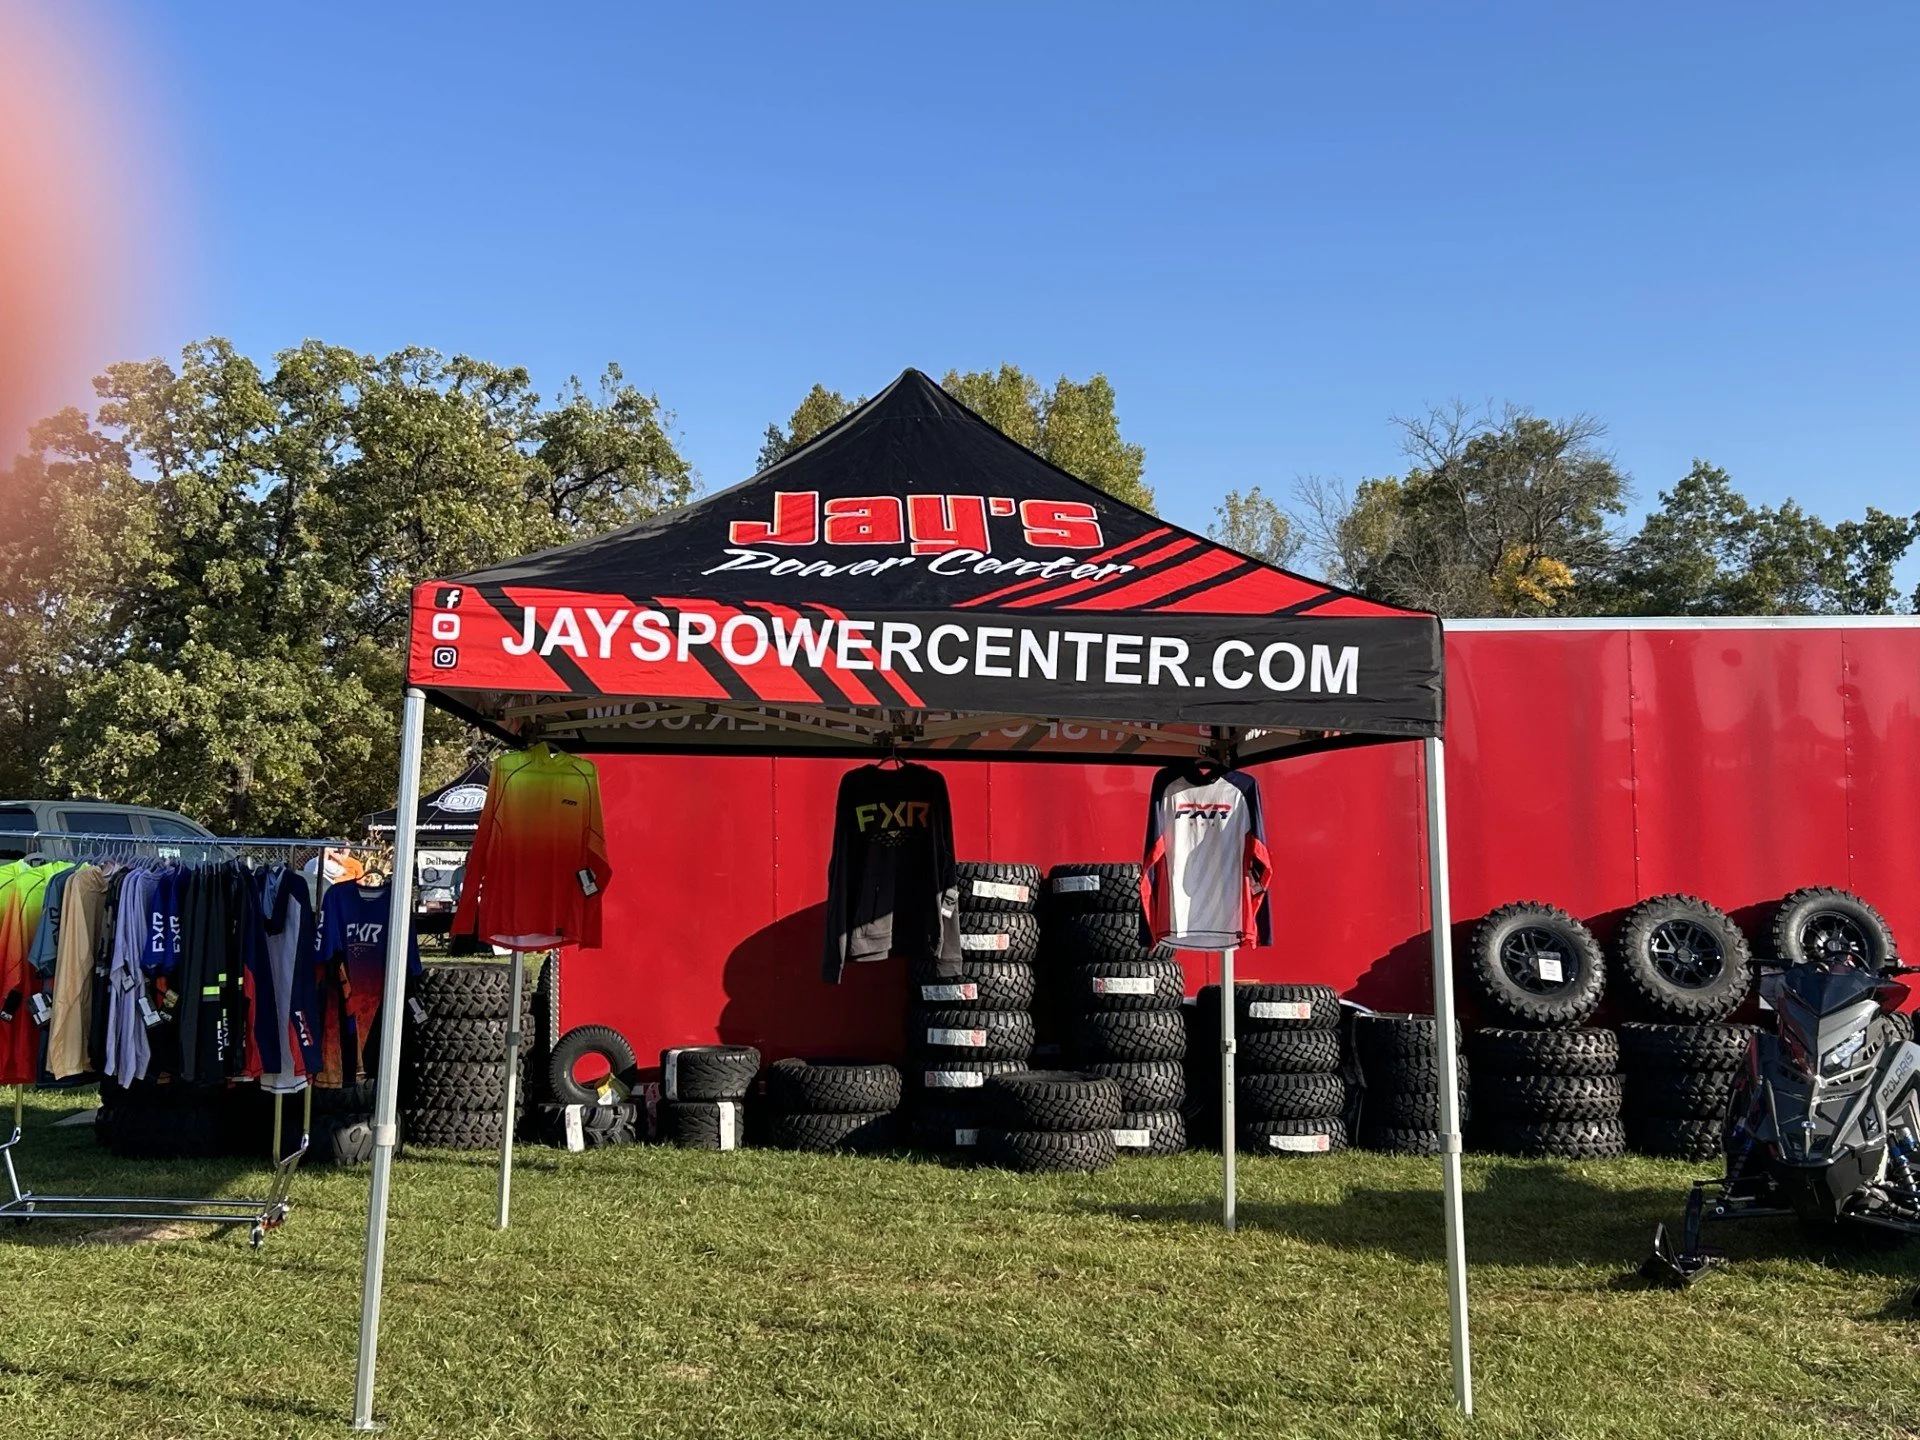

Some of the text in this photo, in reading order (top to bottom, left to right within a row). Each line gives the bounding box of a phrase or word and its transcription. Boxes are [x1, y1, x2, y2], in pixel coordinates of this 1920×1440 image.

[729, 491, 1104, 555] Jay's
[701, 549, 1135, 580] Power Center
[501, 606, 1360, 695] JAYSPOWERCENTER.COM
[855, 801, 930, 832] FXR
[1175, 803, 1232, 819] FXR
[152, 911, 165, 953] FXR
[169, 915, 181, 953] FXR
[346, 923, 383, 943] FXR
[1881, 1050, 1914, 1101] POLARIS
